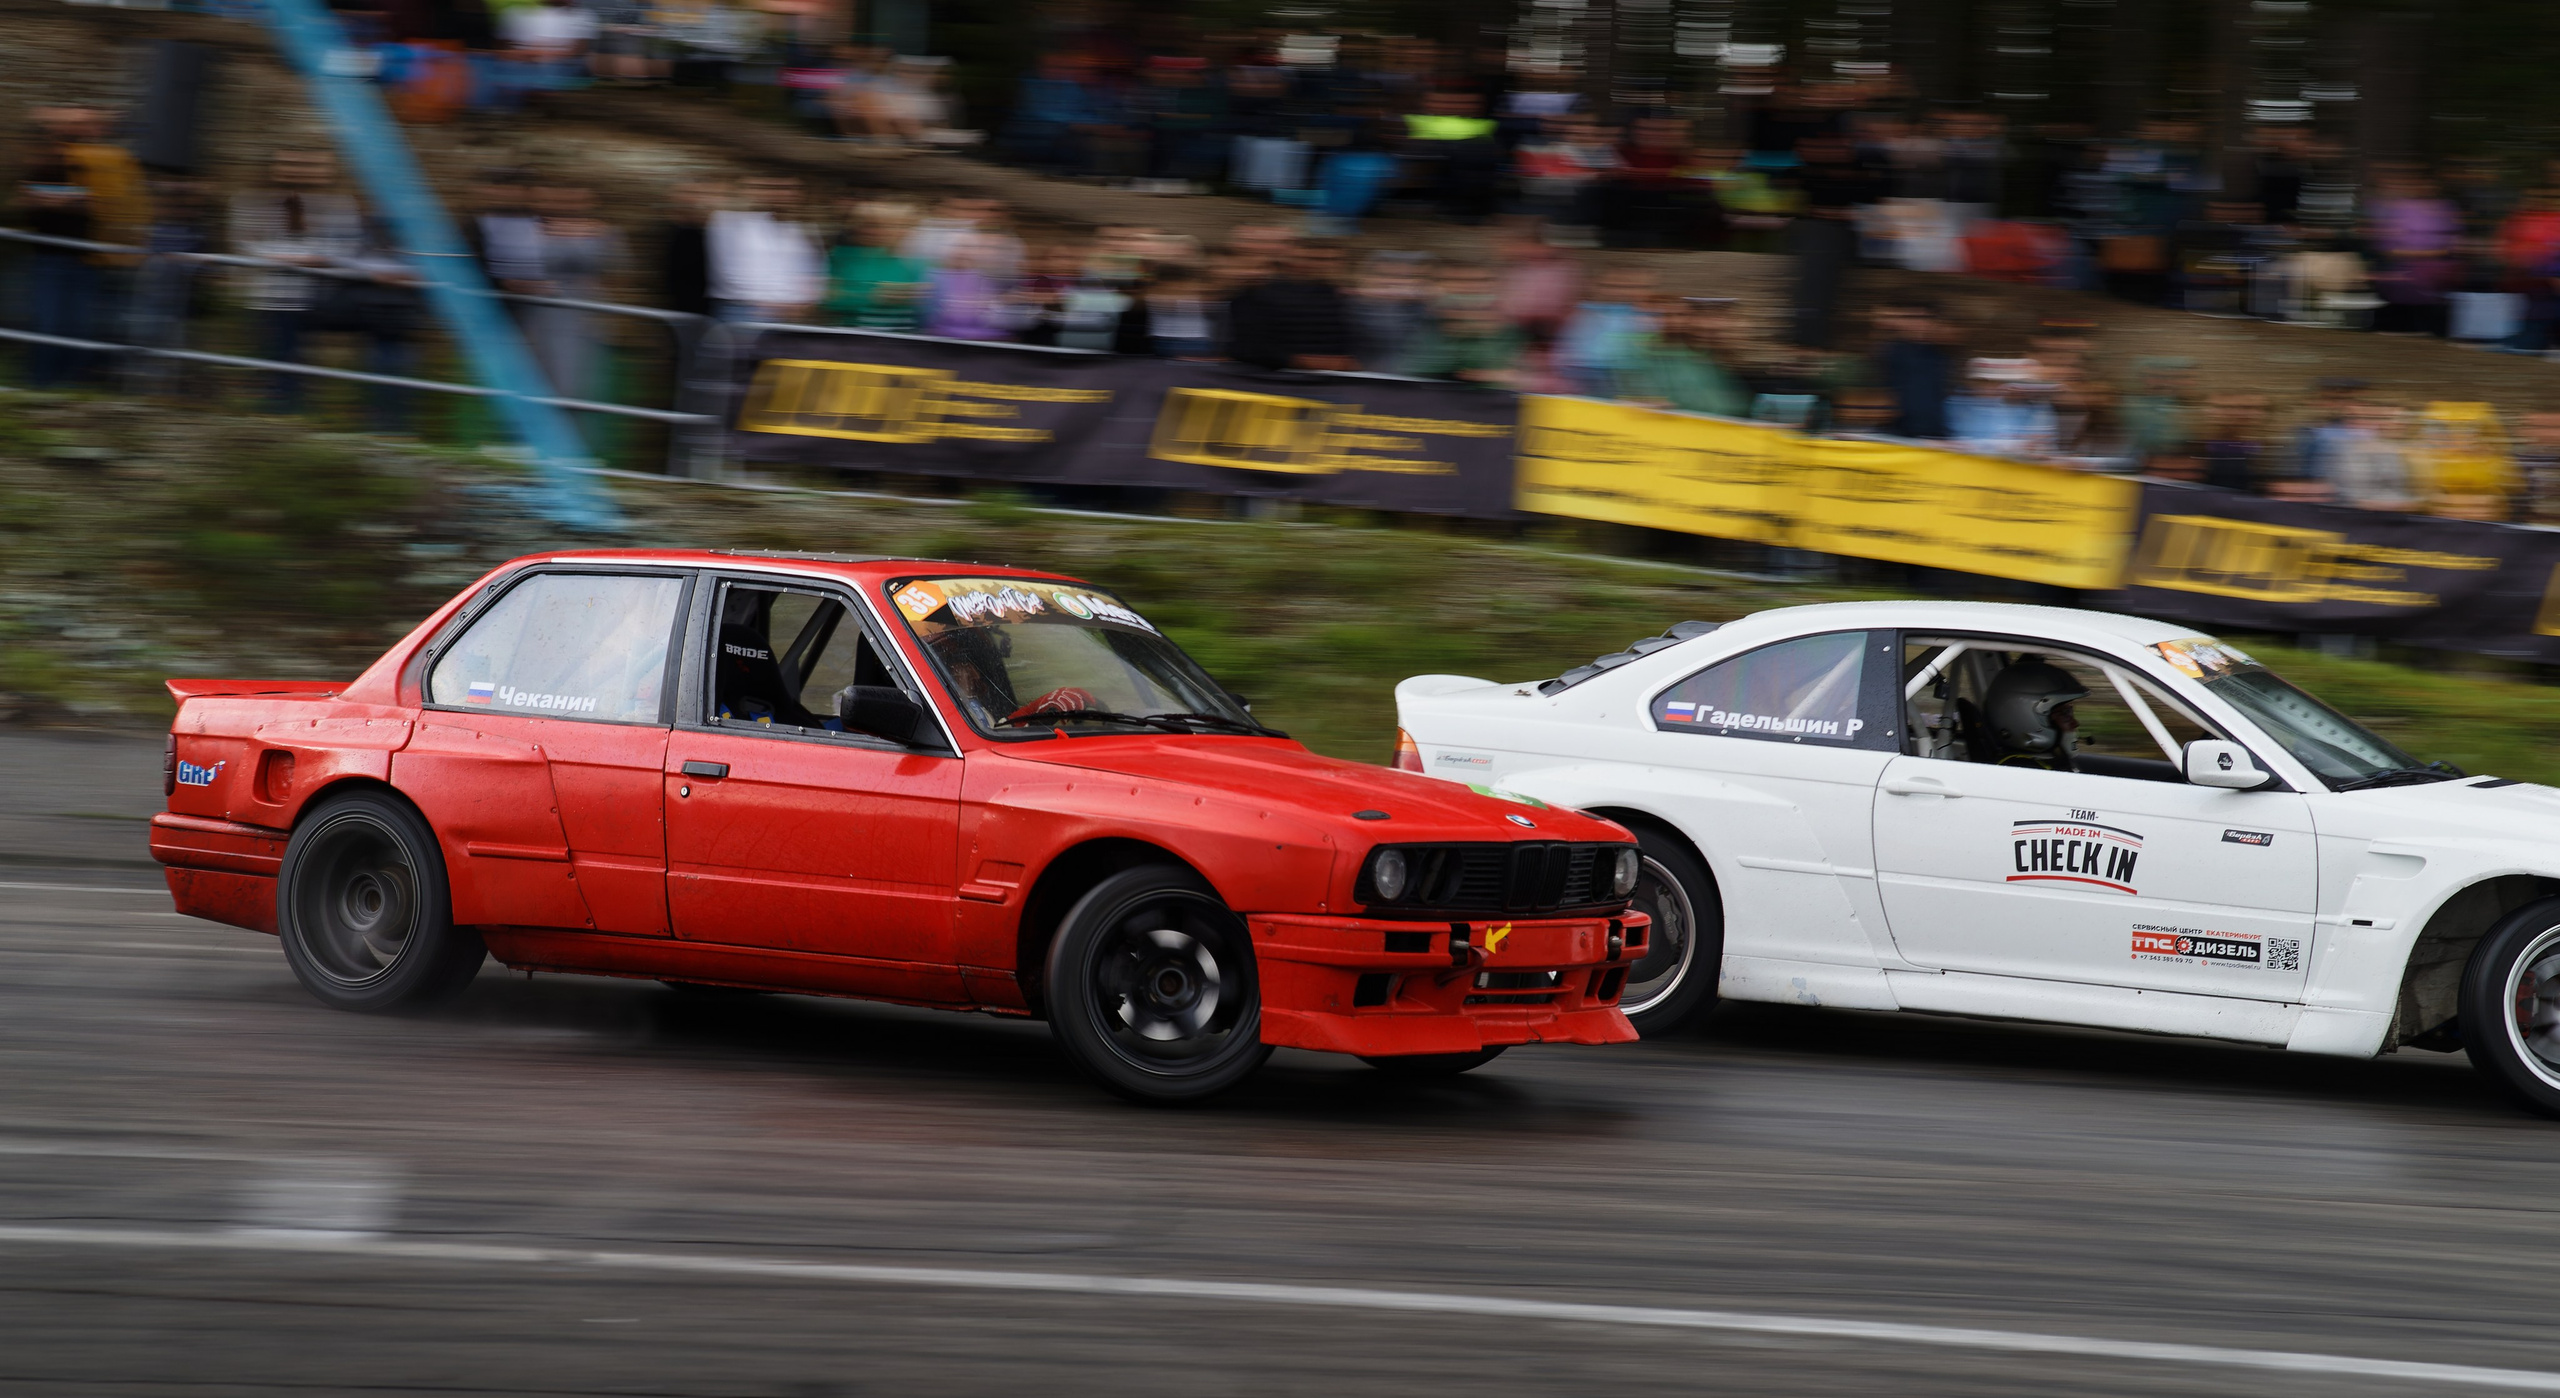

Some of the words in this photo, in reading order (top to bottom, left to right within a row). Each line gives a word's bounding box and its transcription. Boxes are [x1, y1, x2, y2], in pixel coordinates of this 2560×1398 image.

[897, 587, 939, 615] 35
[725, 643, 769, 660] BRIDE
[499, 685, 597, 712] Чеканин
[1696, 705, 1838, 735] Гадельшин
[1845, 718, 1864, 737] Р
[2055, 826, 2086, 837] MADE
[2088, 829, 2101, 838] IN
[2014, 839, 2104, 876] CHECK
[2105, 846, 2138, 884] IN
[2132, 924, 2177, 934] СЕРВИСНЫЙ
[2179, 927, 2203, 935] ЦЕНТР
[2206, 929, 2262, 940] ЕКАТЕРИНБУРГ
[2194, 941, 2258, 958] ДИЗЕЛЬ
